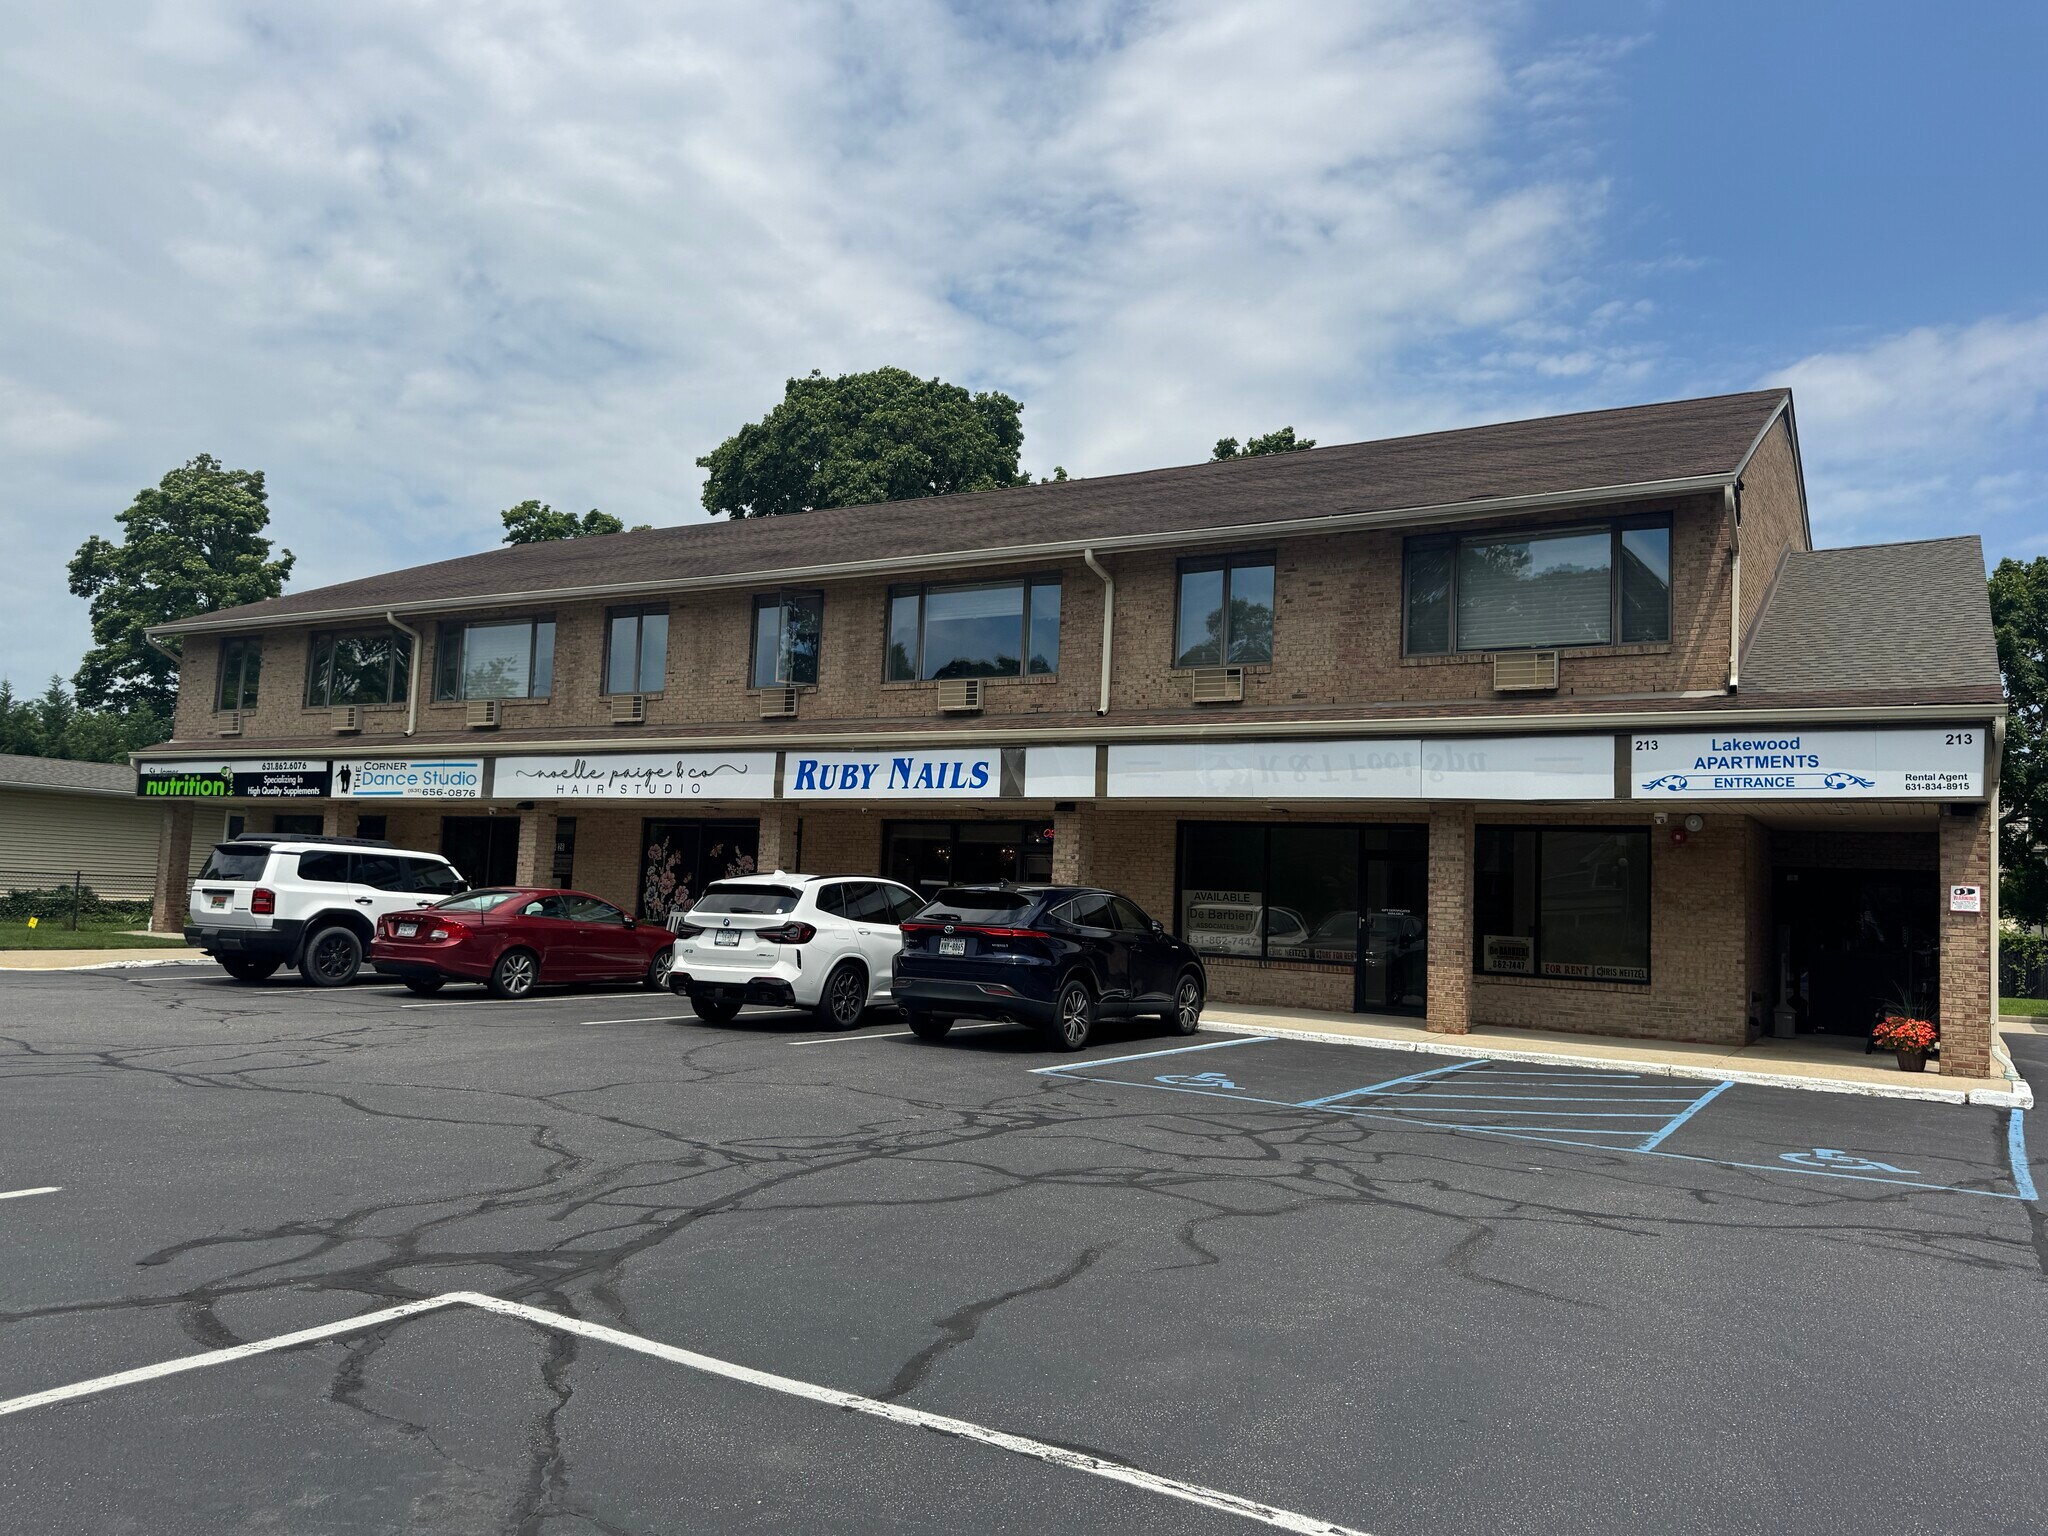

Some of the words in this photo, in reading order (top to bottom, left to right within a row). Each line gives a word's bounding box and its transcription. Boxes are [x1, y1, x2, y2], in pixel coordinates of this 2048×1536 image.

[1712, 737, 1801, 752] Lakewood
[1945, 733, 1973, 745] 213
[1635, 740, 1659, 751] 213
[262, 761, 307, 771] 631.862.6076
[363, 761, 408, 771] CORNER
[1694, 754, 1819, 770] APARTMENTS
[353, 765, 362, 790] THE
[362, 771, 418, 786] Dance
[423, 771, 477, 786] Studio
[516, 759, 605, 779] noelle
[608, 767, 673, 789] paige
[676, 760, 684, 779] &
[793, 759, 880, 790] RUBY
[887, 757, 990, 790] NAILS
[1905, 773, 1935, 782] Rental
[1937, 773, 1968, 783] Agent
[146, 774, 225, 796] nutrition
[263, 775, 296, 785] Specializing
[297, 776, 304, 784] In
[1714, 777, 1795, 788] ENTRANCE
[247, 786, 261, 796] High
[261, 787, 283, 797] Quality
[283, 787, 320, 797] Supplements
[422, 788, 476, 797] 656-0876
[556, 784, 605, 795] HAIR
[620, 783, 701, 795] STUDIO
[1905, 782, 1970, 791] 631-834-8915
[1193, 891, 1250, 903] AVAILABLE
[1190, 908, 1204, 919] De
[1208, 909, 1253, 921] Barbieri
[1187, 934, 1257, 947] 631-862-7447
[1545, 963, 1561, 974] FOR
[1565, 965, 1588, 976] RENT
